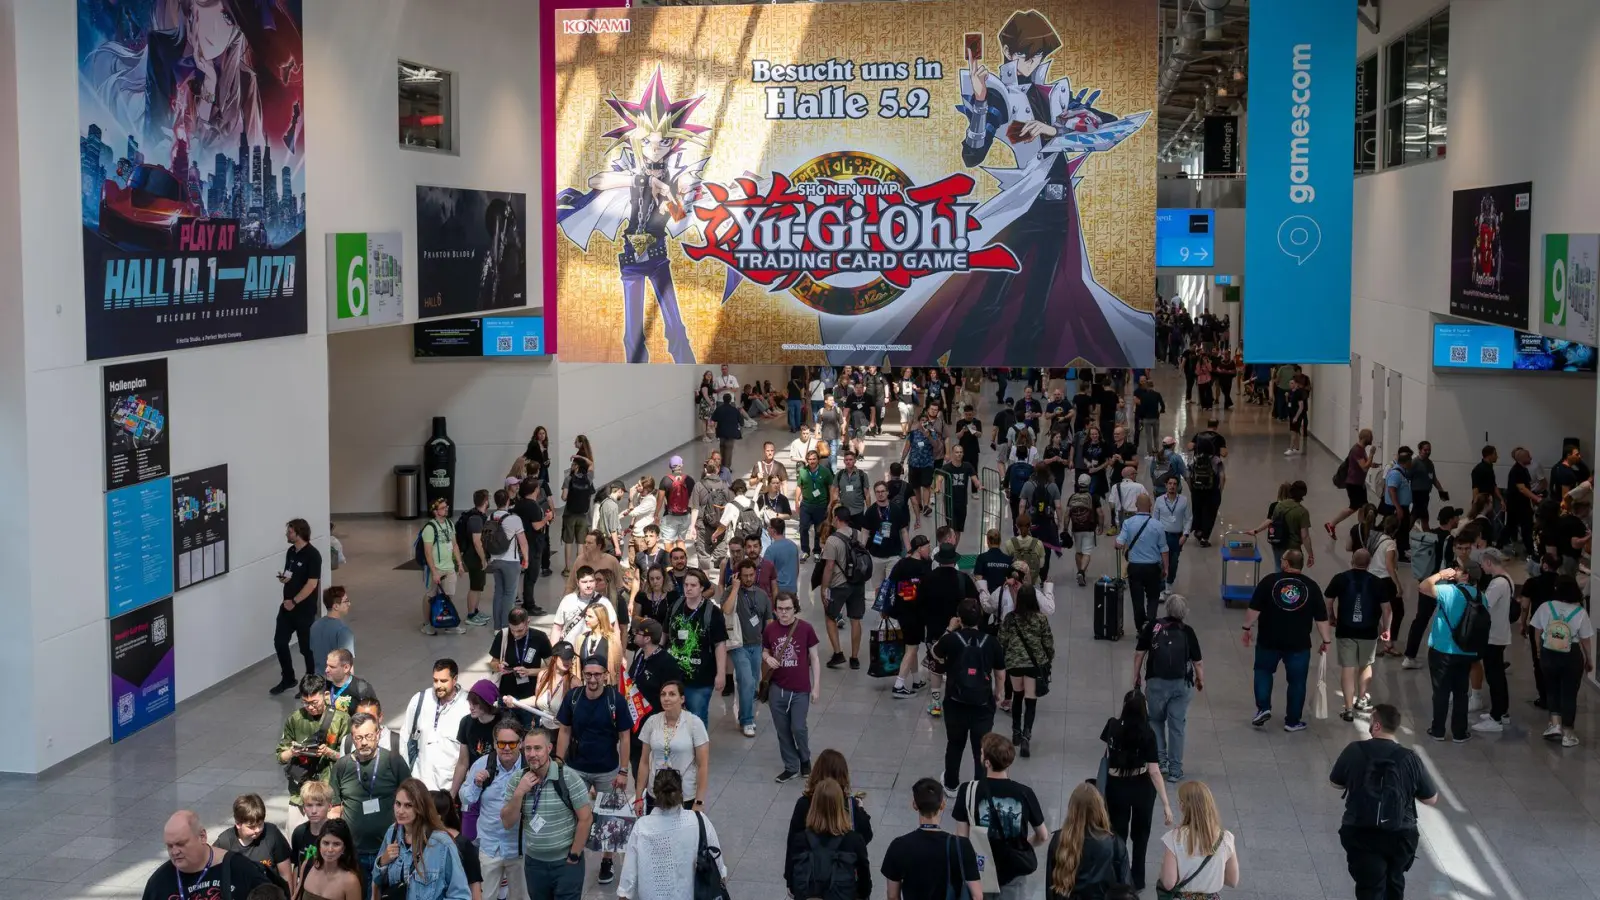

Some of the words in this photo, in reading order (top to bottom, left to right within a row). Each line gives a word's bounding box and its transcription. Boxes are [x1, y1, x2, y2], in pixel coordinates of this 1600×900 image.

[563, 19, 630, 34] KONAMI
[752, 59, 855, 83] Besucht
[860, 62, 911, 81] uns
[914, 58, 942, 80] in
[765, 86, 869, 120] Halle
[877, 86, 930, 119] 5.2
[1290, 43, 1315, 204] gamescom
[1222, 121, 1234, 168] Lindbergh
[798, 183, 858, 197] SHONEN
[859, 183, 899, 198] JUMP
[180, 223, 214, 251] PLAY
[217, 224, 236, 250] AT
[728, 203, 978, 251] Yu-Gi-Oh!
[735, 252, 831, 270] TRADING
[836, 252, 897, 270] CARD
[903, 252, 968, 270] GAME
[1180, 246, 1189, 262] 9
[104, 257, 169, 310] HALL
[347, 255, 366, 317] 6
[1552, 258, 1566, 325] 9
[109, 378, 147, 392] Hallenplan
